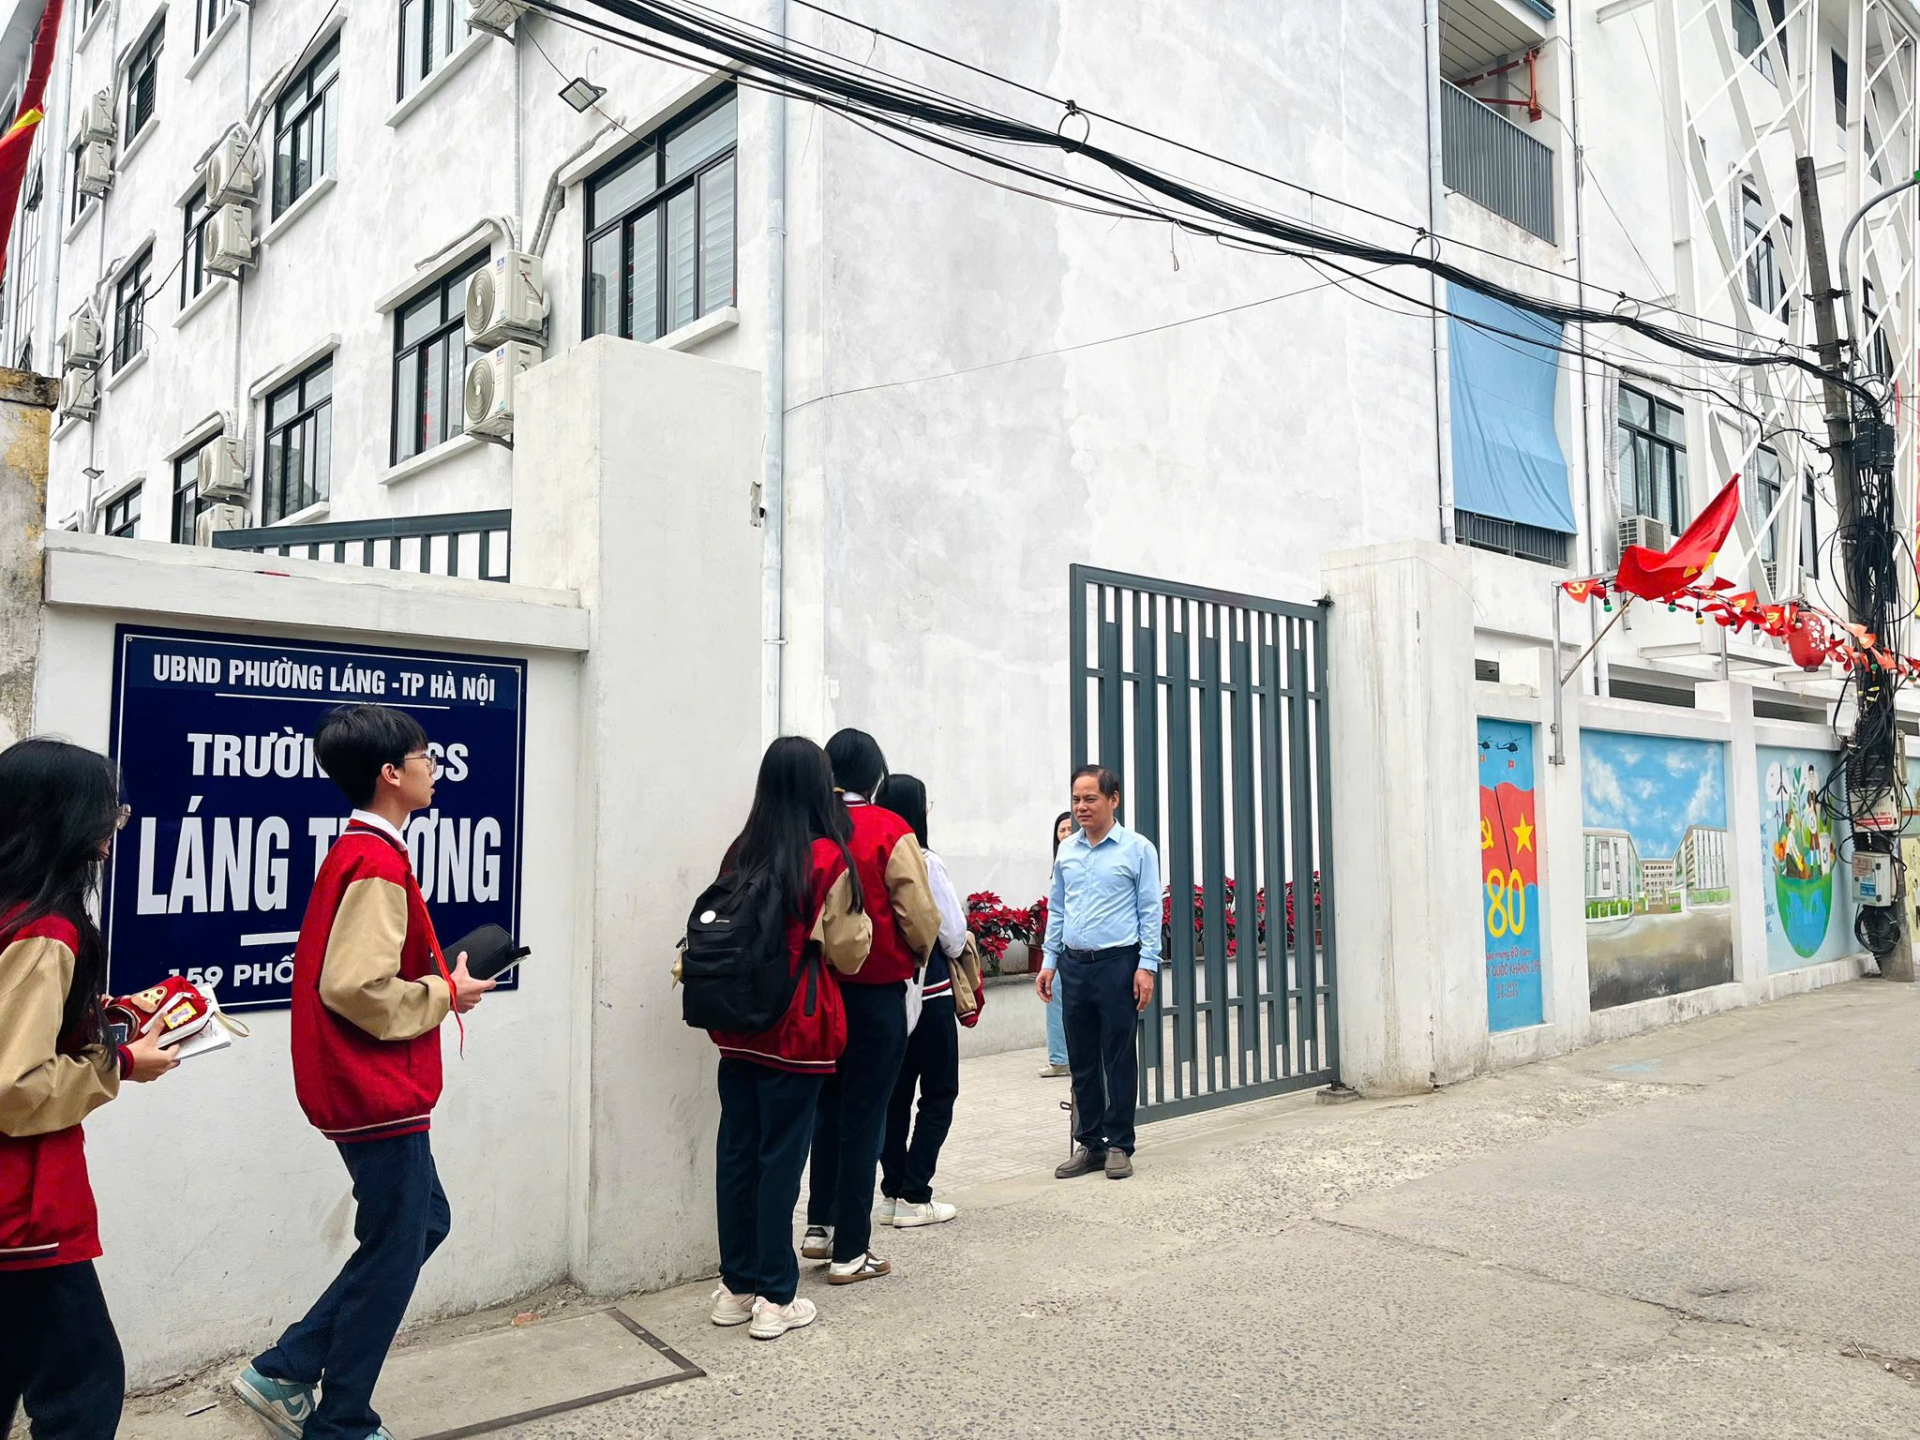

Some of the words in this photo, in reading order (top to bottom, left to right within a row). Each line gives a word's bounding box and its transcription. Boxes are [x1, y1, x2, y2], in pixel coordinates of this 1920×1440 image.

[153, 653, 221, 684] UBND
[228, 656, 323, 691] PHƯỜNG
[329, 663, 386, 695] LÁNG
[430, 670, 457, 699] HÀ
[462, 673, 496, 706] NỘI
[187, 726, 330, 778] TRƯỜN
[136, 795, 290, 915] LÁNG
[308, 808, 501, 904] TƠNG
[1487, 868, 1525, 937] 80
